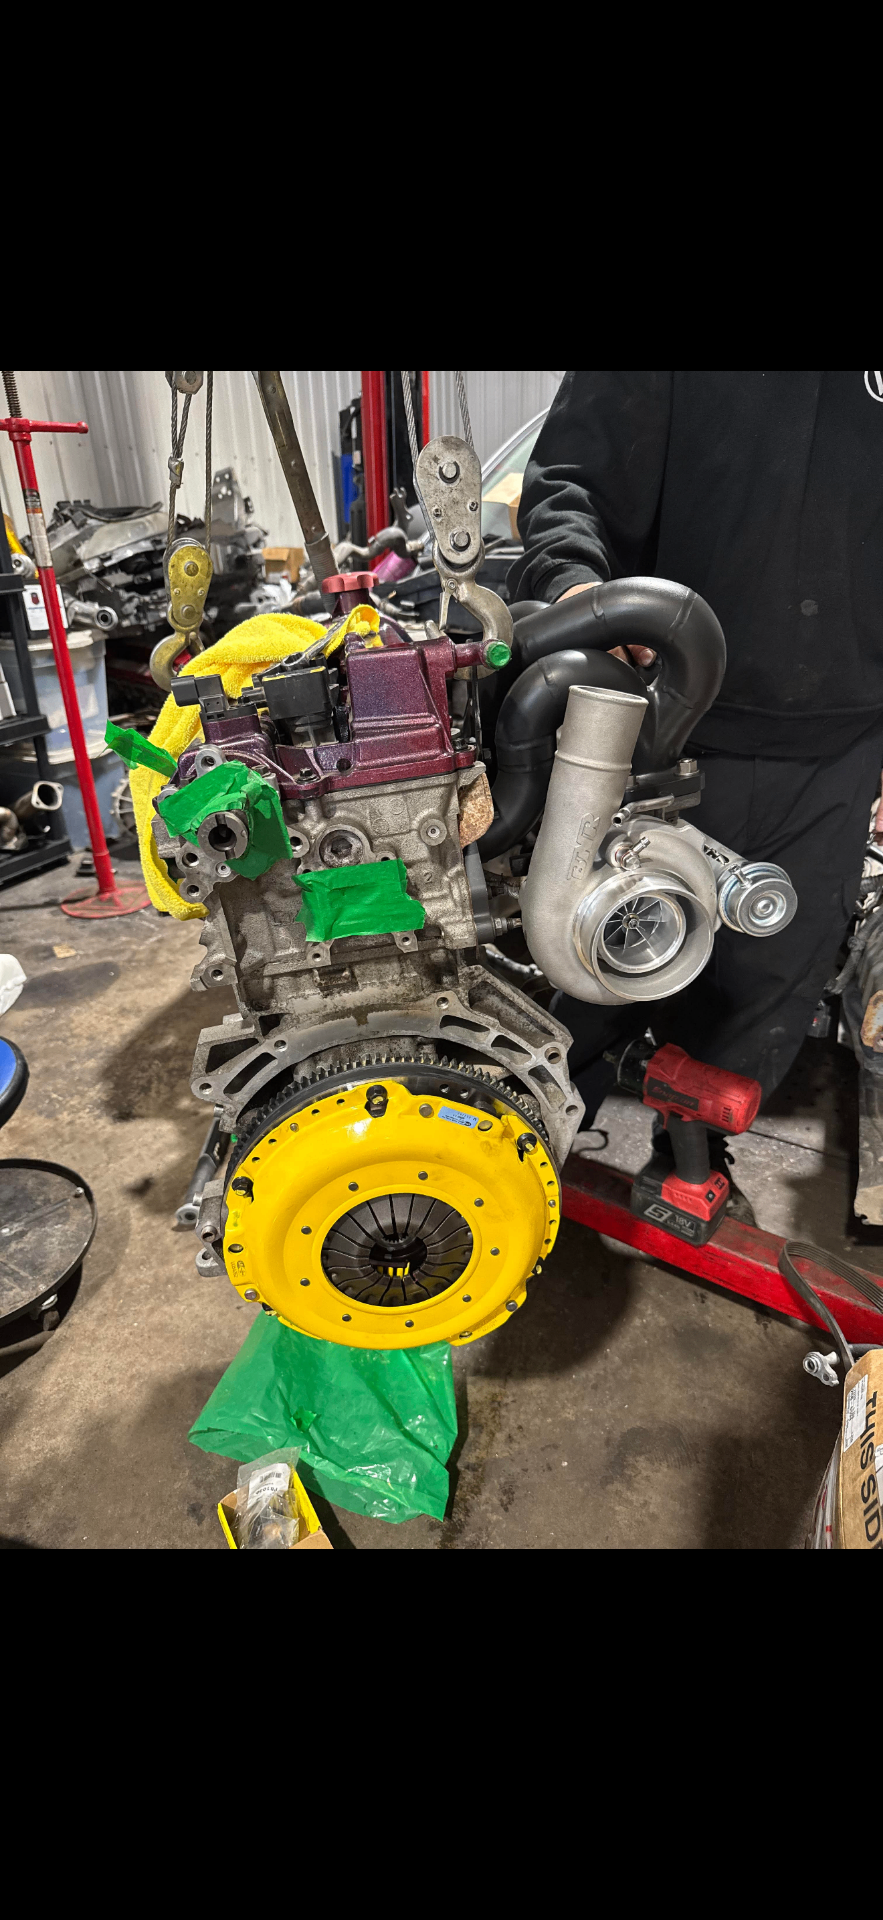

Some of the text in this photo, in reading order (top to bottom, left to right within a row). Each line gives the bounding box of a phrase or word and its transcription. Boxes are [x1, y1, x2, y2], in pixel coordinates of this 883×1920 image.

[675, 1213, 693, 1229] 18V
[860, 1390, 883, 1549] THIS SID
